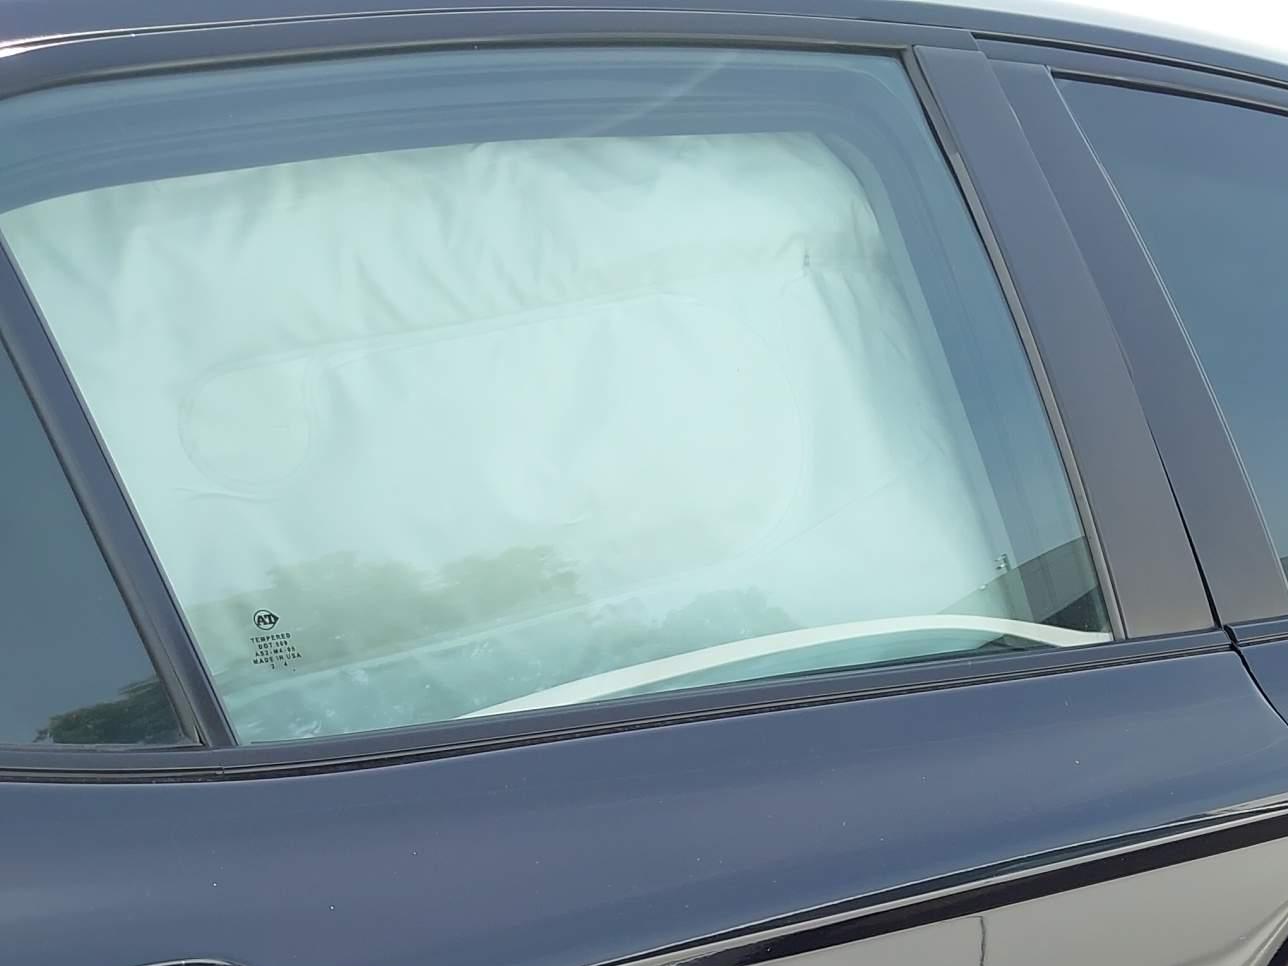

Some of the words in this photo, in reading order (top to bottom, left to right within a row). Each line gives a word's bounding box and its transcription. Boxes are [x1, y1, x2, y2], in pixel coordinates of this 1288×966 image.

[250, 632, 291, 643] TEMPERED
[253, 656, 274, 665] MADE
[286, 652, 302, 660] USA
